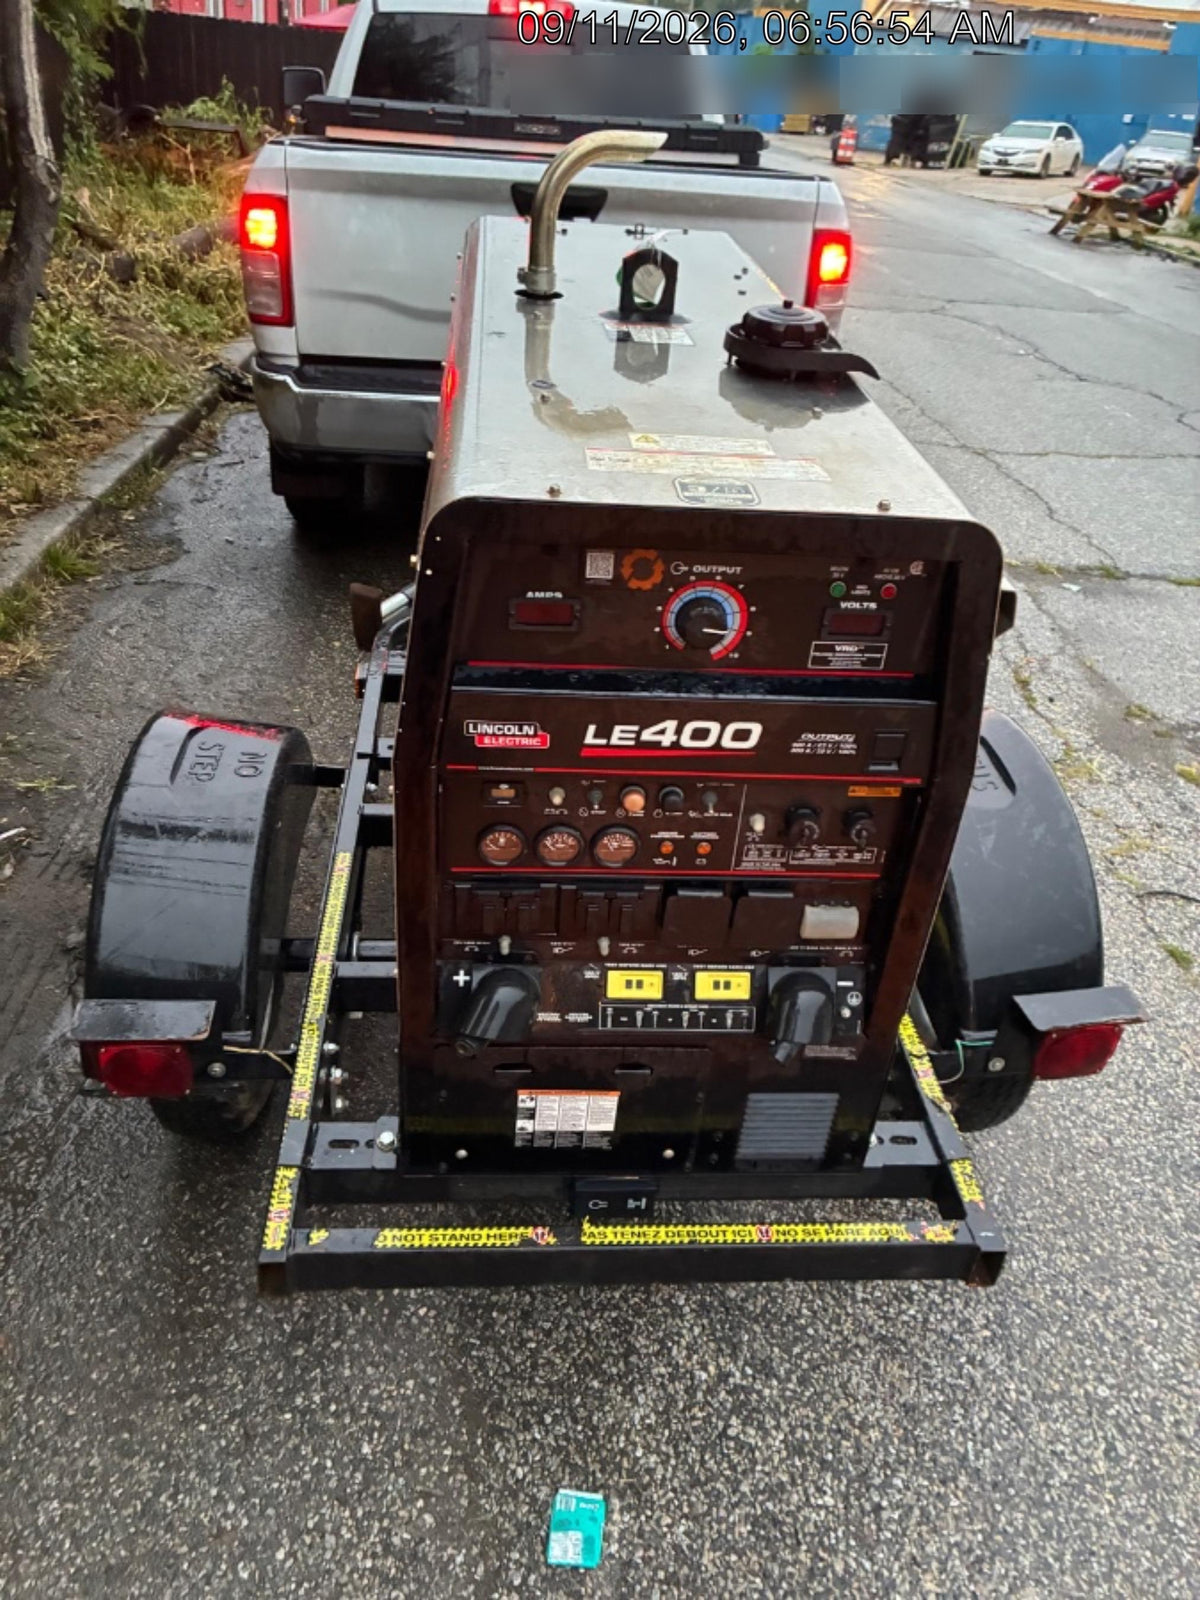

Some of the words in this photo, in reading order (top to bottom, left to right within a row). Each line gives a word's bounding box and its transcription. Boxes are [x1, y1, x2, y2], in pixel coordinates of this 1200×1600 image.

[692, 565, 743, 575] OUTPUT
[840, 601, 877, 610] VOLTS
[468, 723, 535, 735] LINCOLN
[583, 719, 763, 749] LE400
[483, 736, 541, 746] ELECTRIC
[188, 741, 226, 782] STEP
[233, 751, 268, 778] NO
[392, 1233, 425, 1243] NOT
[428, 1232, 483, 1242] STAND
[612, 1230, 662, 1240] TENEZ
[664, 1229, 729, 1239] DEBOUT
[732, 1229, 753, 1239] ICI
[775, 1228, 799, 1237] NO
